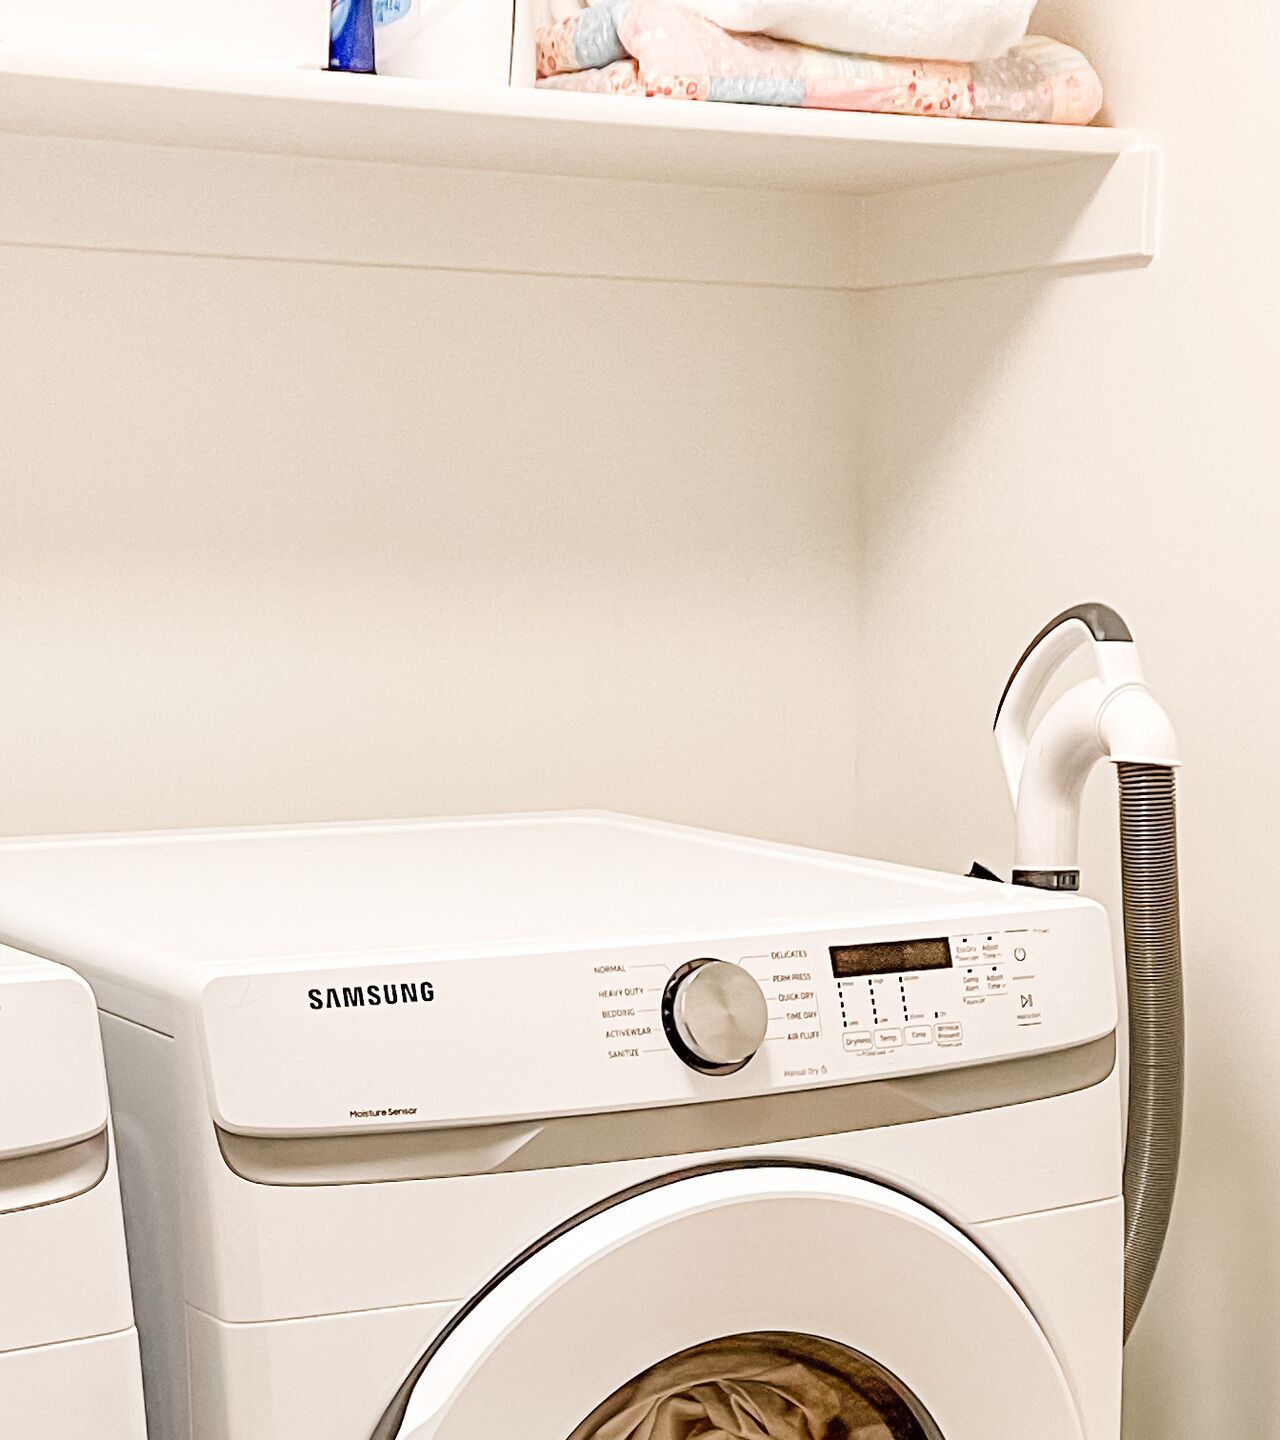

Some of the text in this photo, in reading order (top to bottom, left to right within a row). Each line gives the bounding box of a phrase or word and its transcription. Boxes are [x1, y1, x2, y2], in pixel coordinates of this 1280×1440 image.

[594, 965, 626, 974] NORMAL
[308, 981, 434, 1010] SAMSUNG
[598, 987, 644, 998] HEAVY DUTY
[602, 1008, 635, 1019] BEDDING
[605, 1026, 652, 1038] ACTIVEWEAR
[350, 1107, 418, 1118] Moisture Sensor
